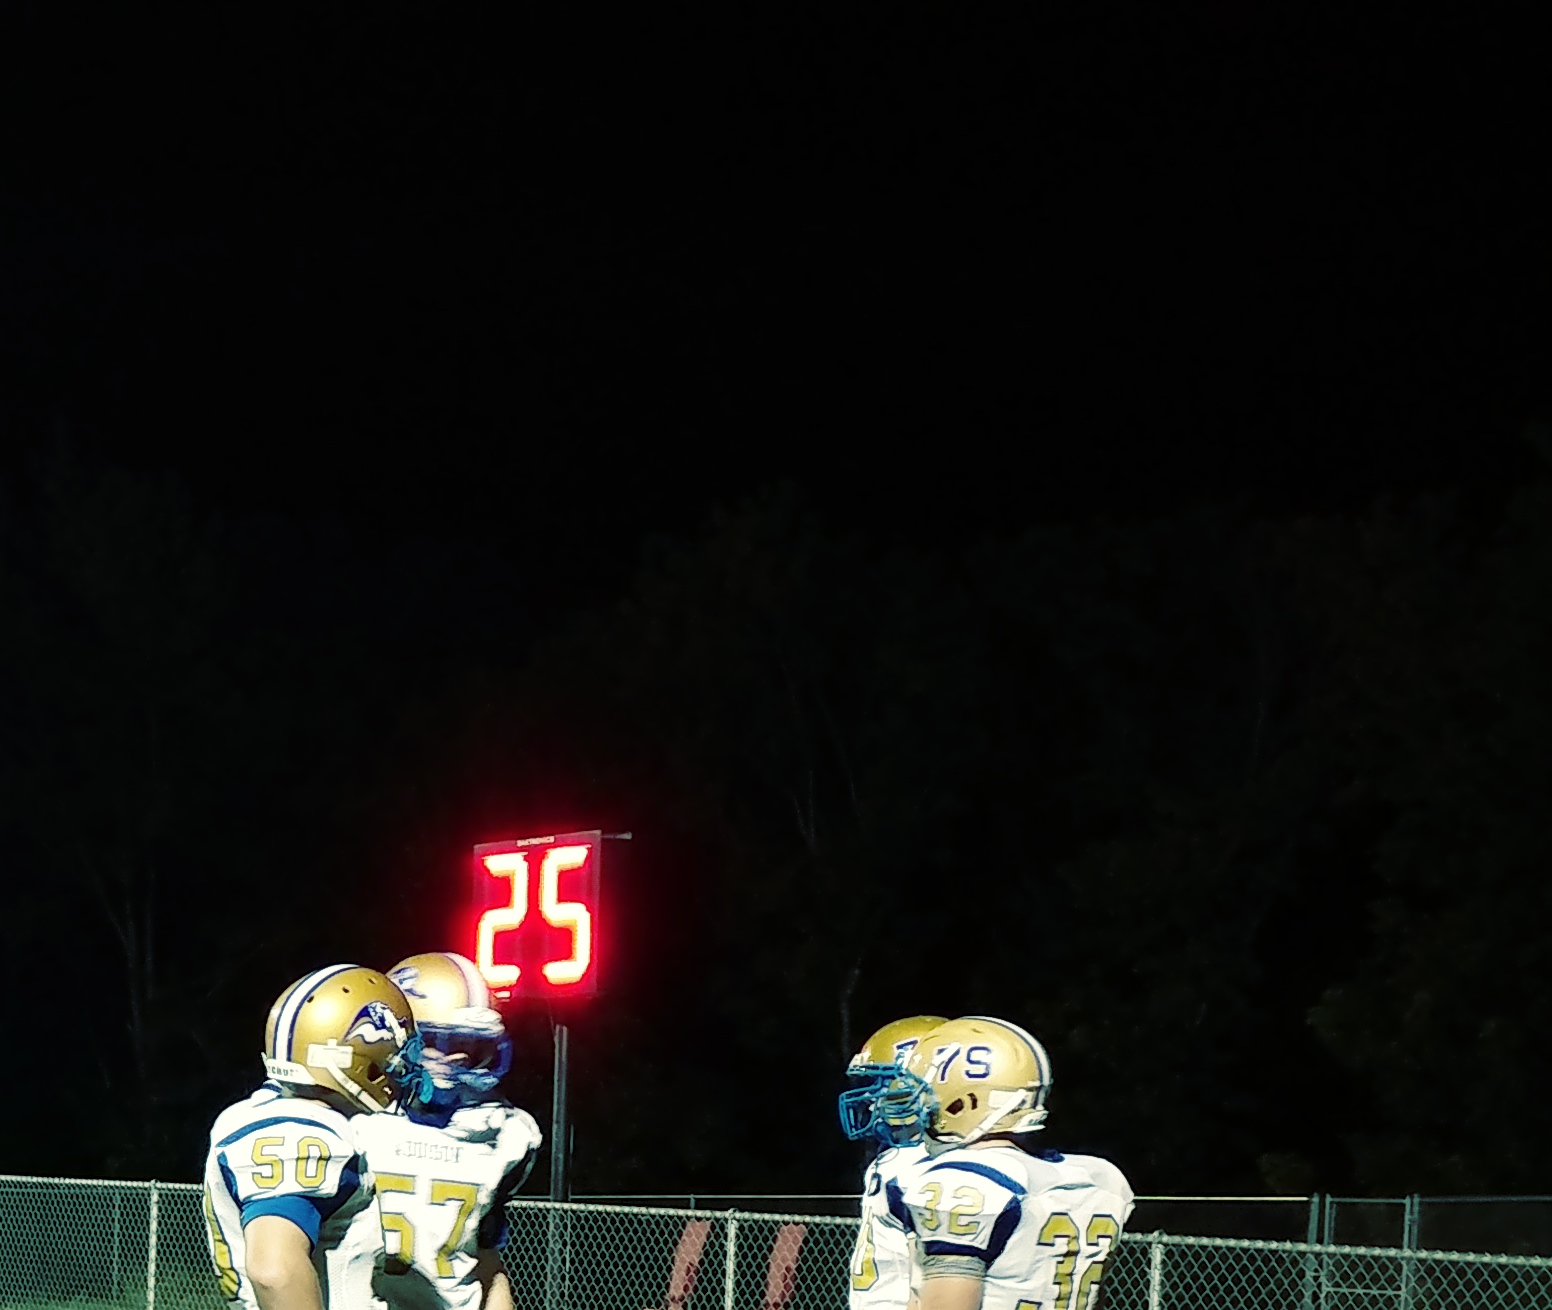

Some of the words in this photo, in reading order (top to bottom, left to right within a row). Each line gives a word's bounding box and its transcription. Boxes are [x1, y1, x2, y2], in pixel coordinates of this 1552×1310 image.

[475, 845, 591, 989] 25
[251, 1135, 332, 1190] 50
[374, 1170, 485, 1280] 57
[917, 1181, 985, 1236] 32
